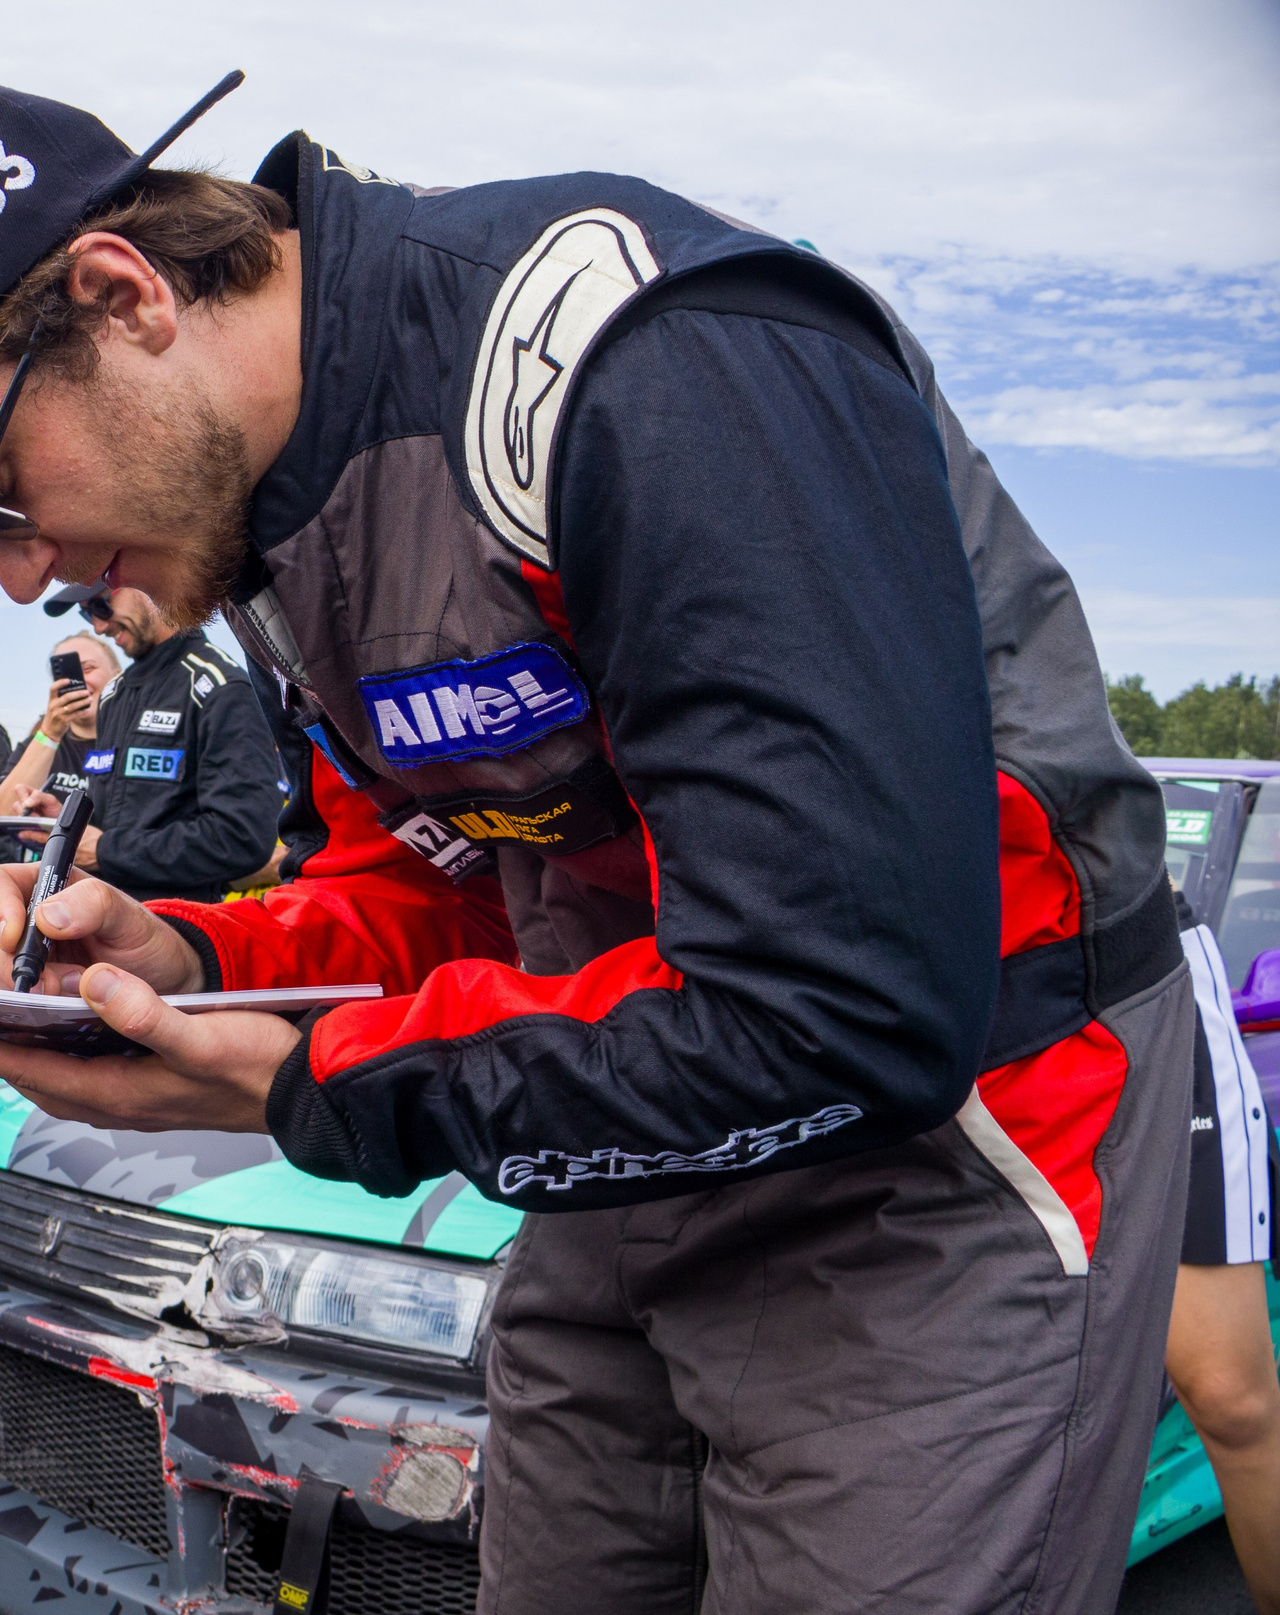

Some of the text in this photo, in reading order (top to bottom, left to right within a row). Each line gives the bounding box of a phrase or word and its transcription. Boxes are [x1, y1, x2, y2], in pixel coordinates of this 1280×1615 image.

[131, 754, 174, 773] RED
[449, 810, 519, 840] ULD
[279, 1584, 308, 1607] OMP
